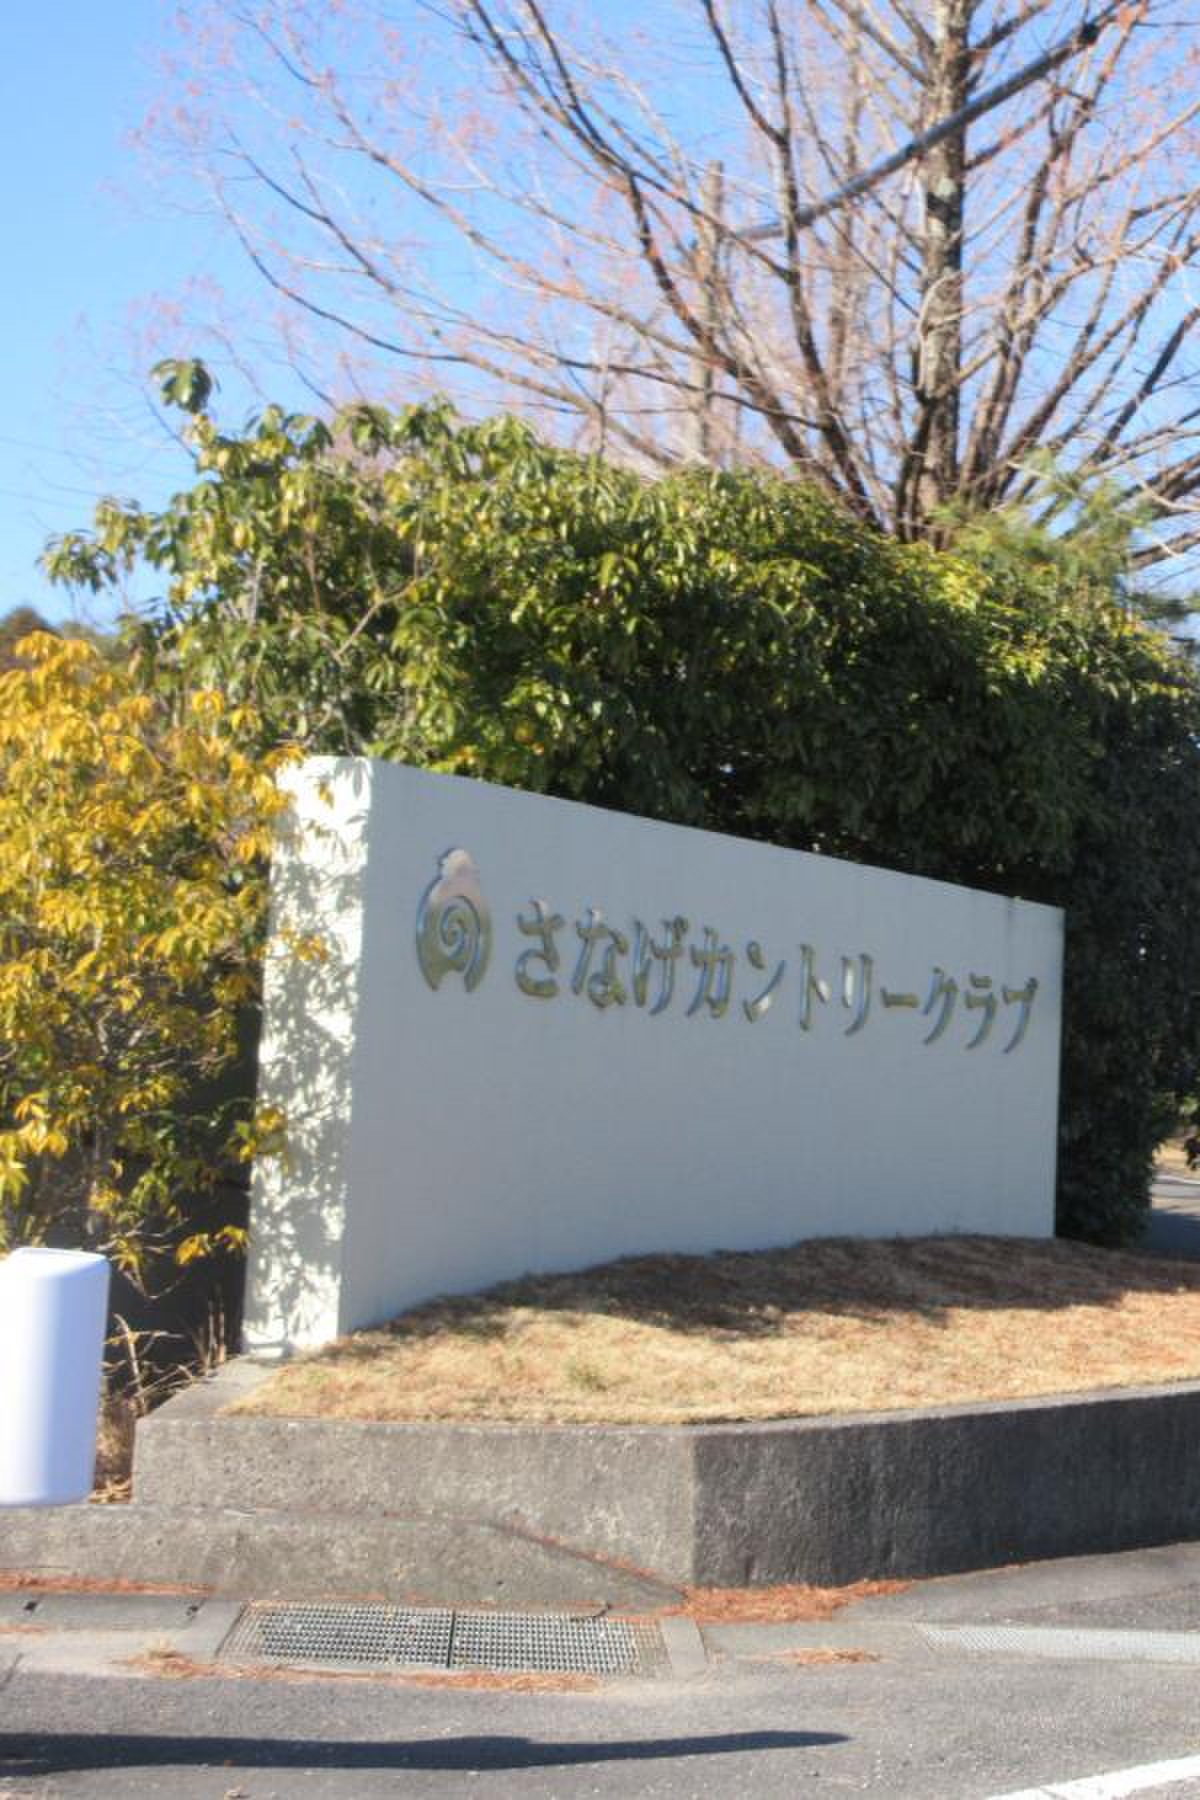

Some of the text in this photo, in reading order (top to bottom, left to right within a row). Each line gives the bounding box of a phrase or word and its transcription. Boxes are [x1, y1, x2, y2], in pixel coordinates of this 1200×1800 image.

[514, 898, 1038, 1054] さなげカントリークラブ
